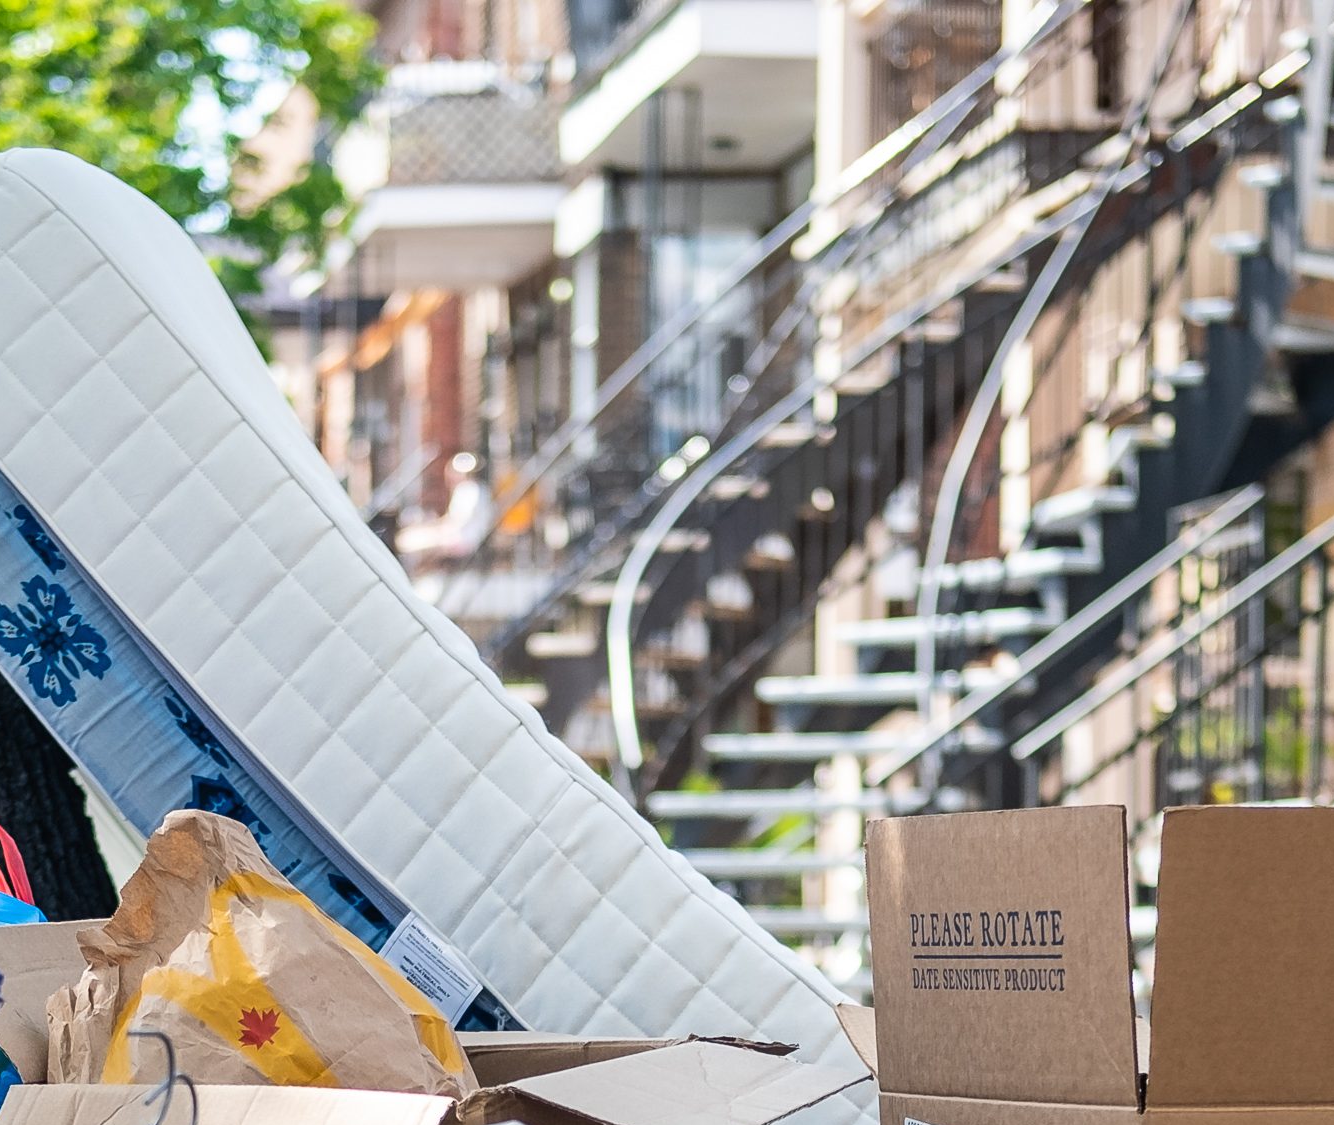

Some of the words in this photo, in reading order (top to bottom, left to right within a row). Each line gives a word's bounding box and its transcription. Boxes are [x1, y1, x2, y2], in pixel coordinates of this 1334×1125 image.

[910, 912, 974, 947] PLEASE
[979, 910, 1065, 947] ROTATE
[912, 967, 940, 990] DATE
[942, 968, 1001, 991] SENSITIVE
[1004, 968, 1066, 992] PRODUCT
